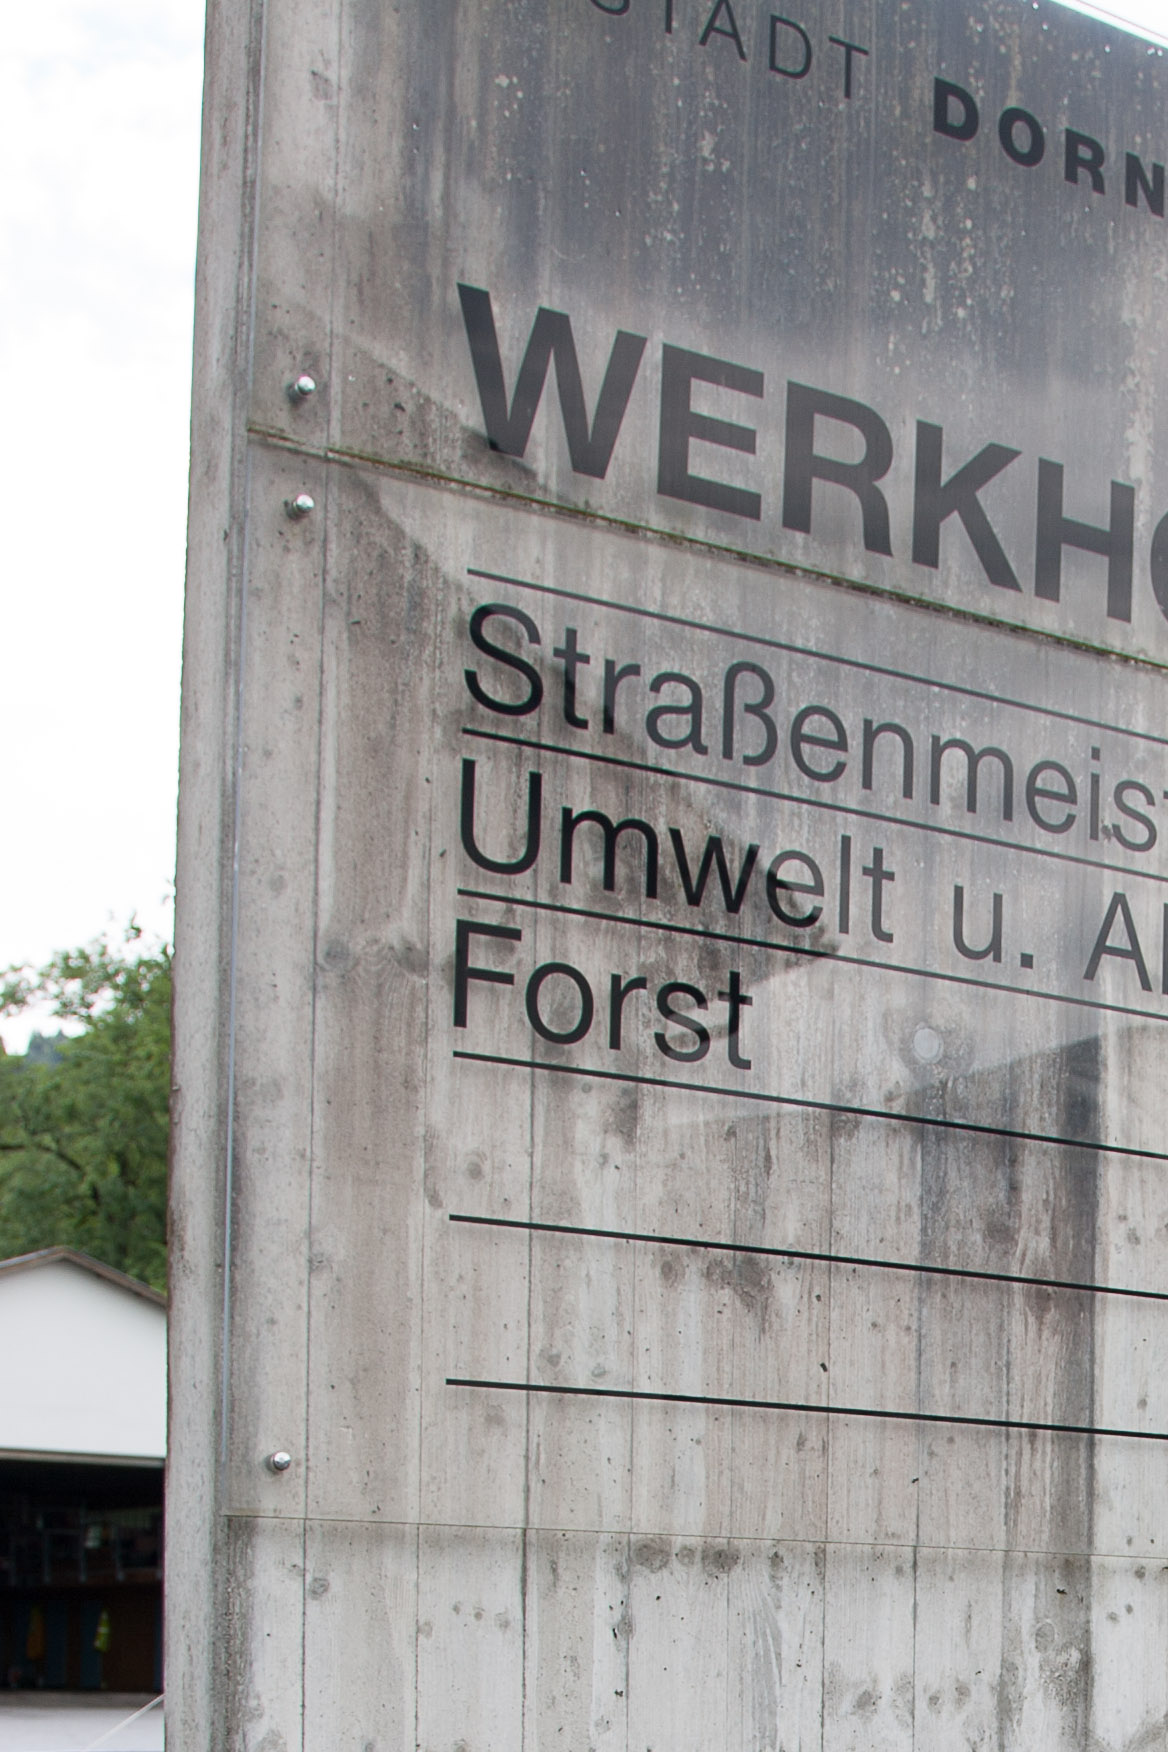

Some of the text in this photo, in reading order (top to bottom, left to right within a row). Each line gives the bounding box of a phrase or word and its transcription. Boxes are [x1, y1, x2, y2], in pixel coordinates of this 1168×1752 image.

[590, 0, 869, 100] ADT
[460, 757, 895, 943] Umwelt
[951, 885, 1034, 968] u.
[452, 919, 752, 1070] Forst
